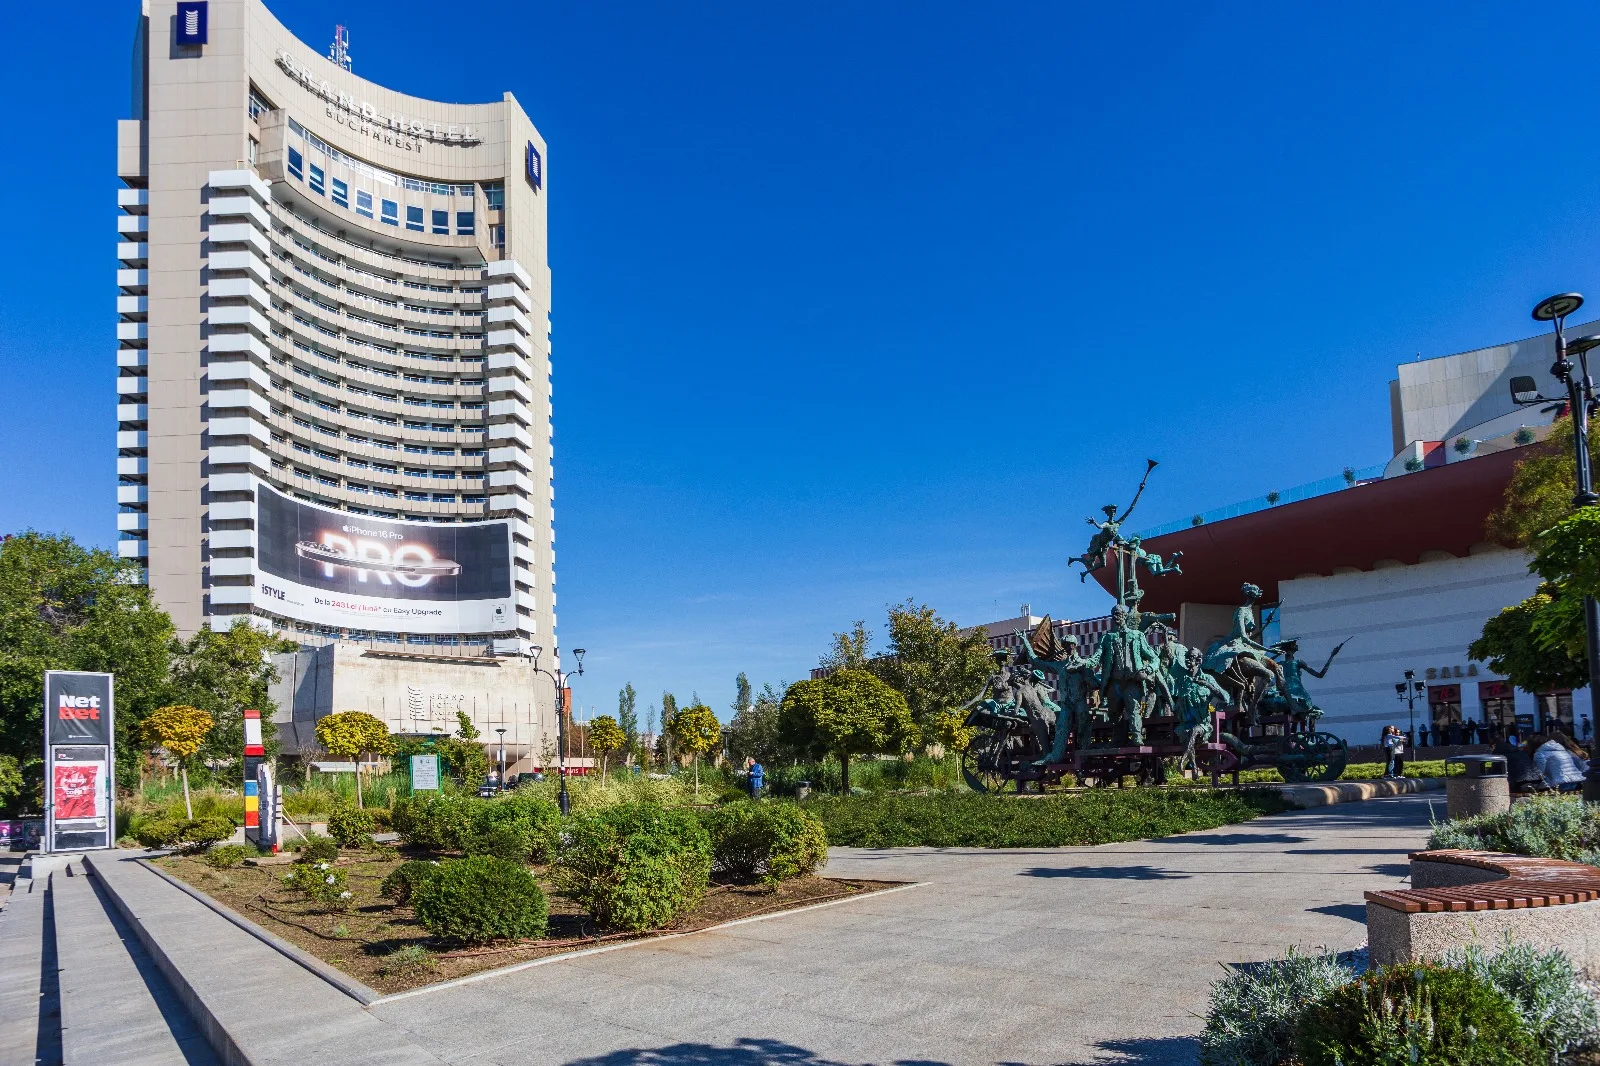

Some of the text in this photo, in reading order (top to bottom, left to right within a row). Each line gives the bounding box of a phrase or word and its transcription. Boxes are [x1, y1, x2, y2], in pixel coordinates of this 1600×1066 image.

[282, 50, 477, 140] GRAND HOTEL
[326, 103, 426, 152] BUCHAREST
[349, 525, 403, 540] iPhone 16 Pro
[323, 533, 433, 587] PRO
[261, 583, 286, 601] iSTYLE
[314, 597, 324, 605] De
[324, 598, 331, 606] la
[346, 602, 357, 610] Lei
[393, 607, 411, 615] Easy
[411, 608, 443, 617] Upgrade
[1426, 664, 1478, 679] SALA
[59, 694, 101, 708] Net
[59, 707, 100, 720] Bet
